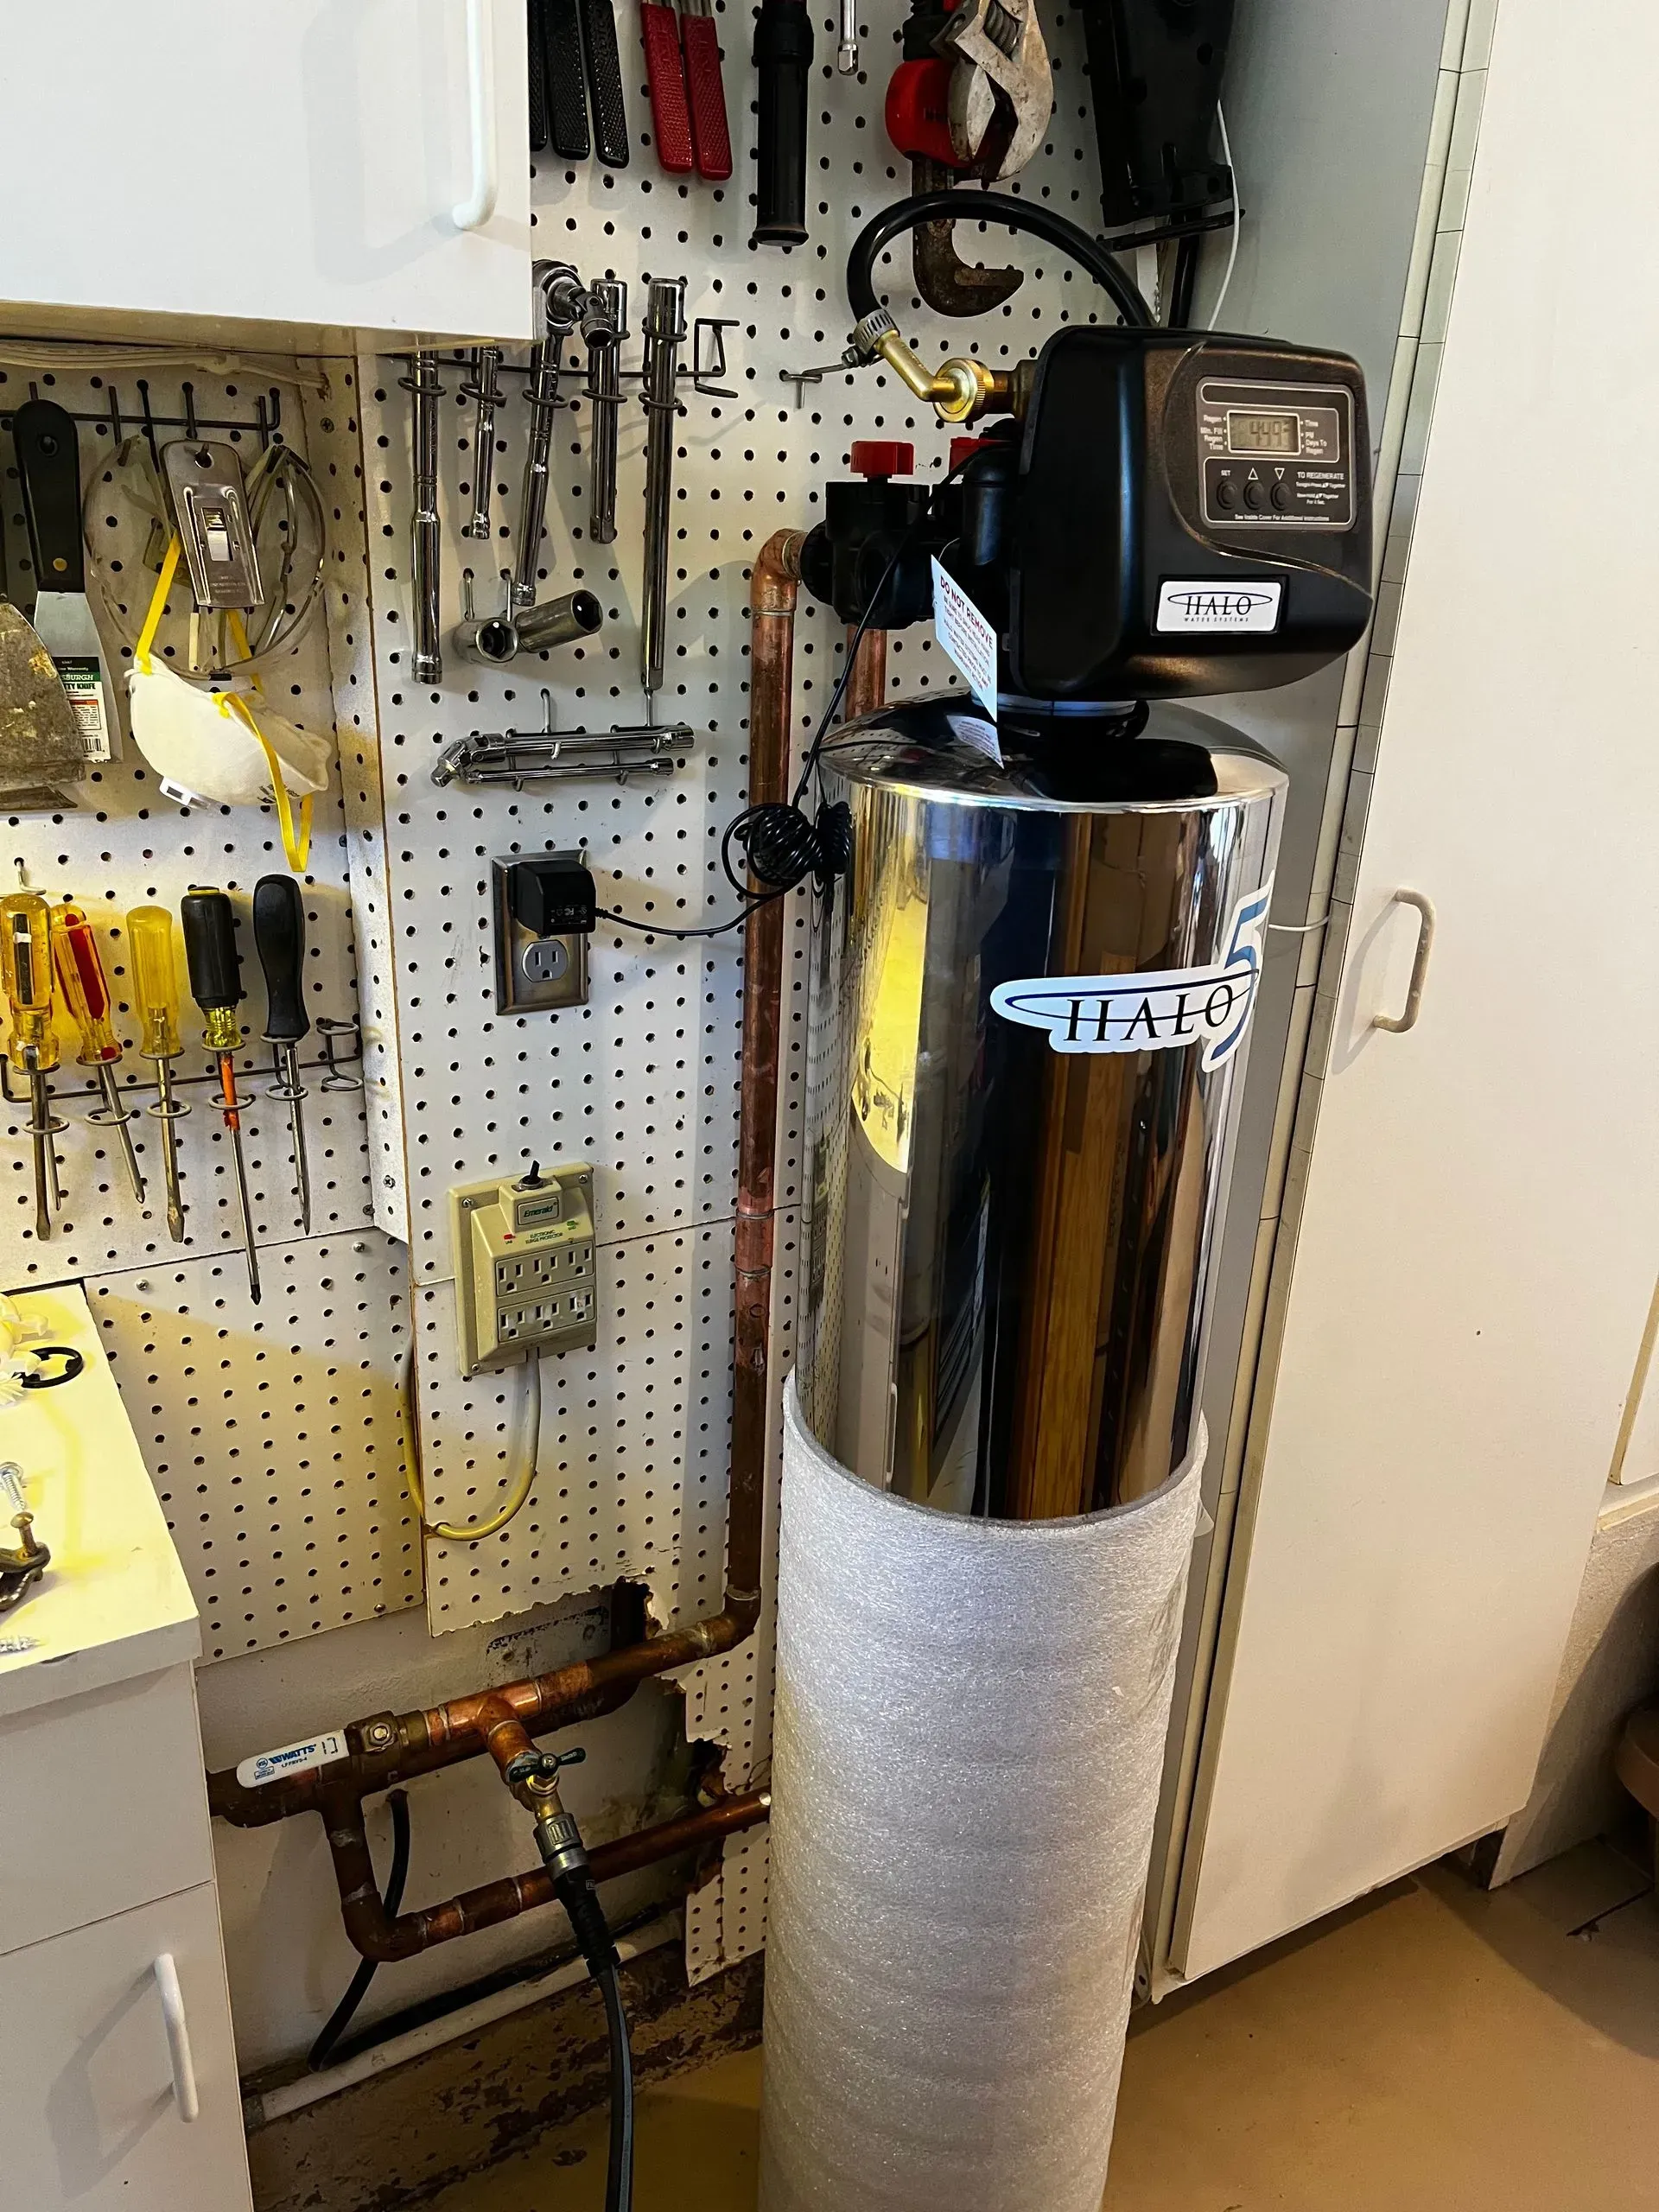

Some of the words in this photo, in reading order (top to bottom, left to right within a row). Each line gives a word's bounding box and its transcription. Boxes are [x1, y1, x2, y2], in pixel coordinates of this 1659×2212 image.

[1306, 472, 1344, 480] REGENERATE
[940, 575, 950, 595] DO
[951, 588, 964, 613] NOT
[966, 606, 993, 650] REMOVE
[1185, 595, 1252, 615] HALO
[1063, 984, 1233, 1042] HALO
[1210, 895, 1269, 1062] 5
[524, 1205, 553, 1217] Emerald
[278, 1744, 315, 1761] WATTS
